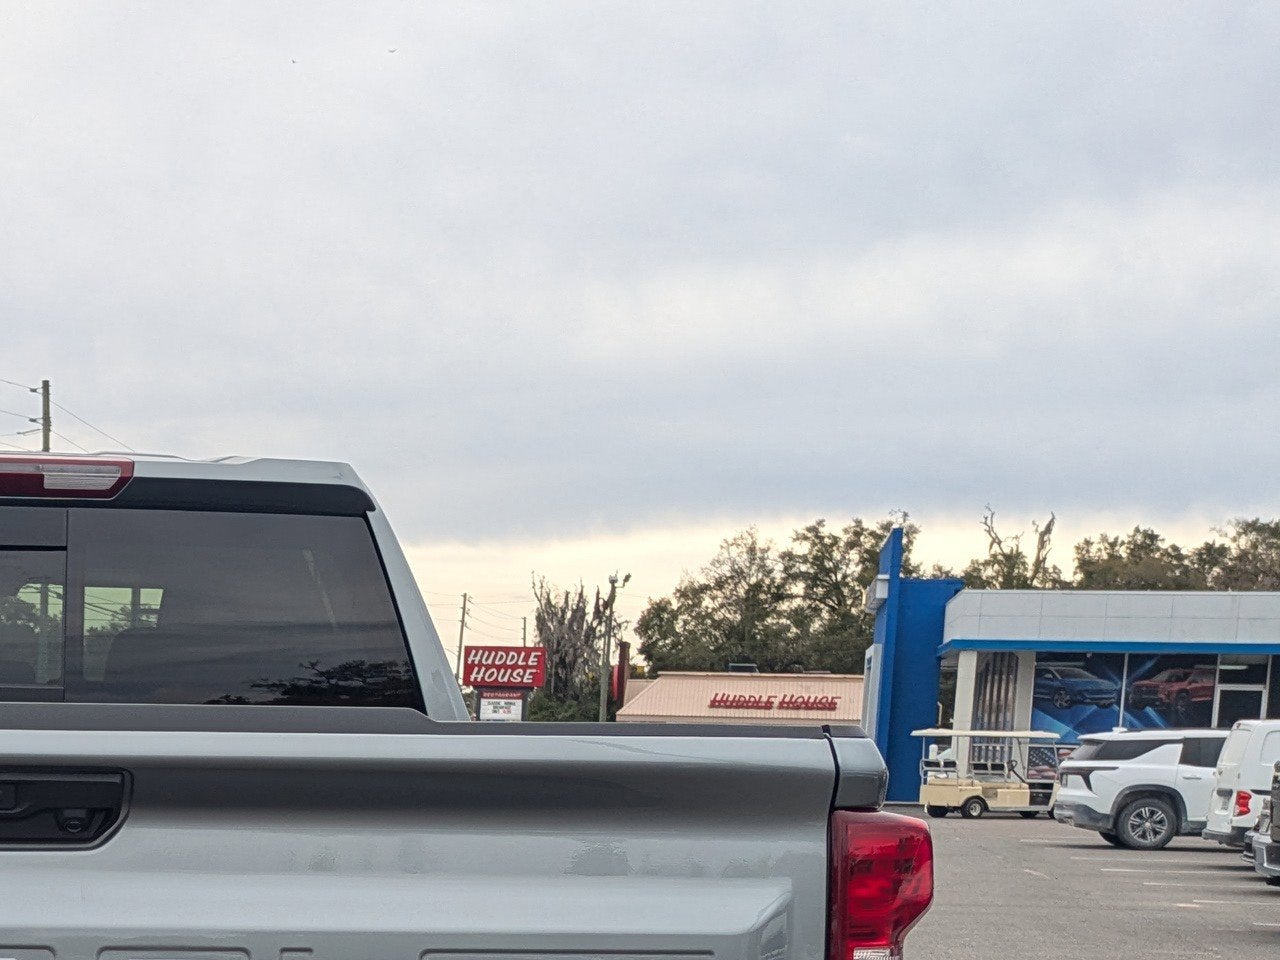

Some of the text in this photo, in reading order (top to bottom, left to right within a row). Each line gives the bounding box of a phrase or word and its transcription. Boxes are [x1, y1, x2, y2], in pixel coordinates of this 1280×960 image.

[467, 649, 542, 665] HUDDLE
[469, 666, 537, 682] HOUSE
[708, 692, 842, 711] HUDDLE HOUSE
